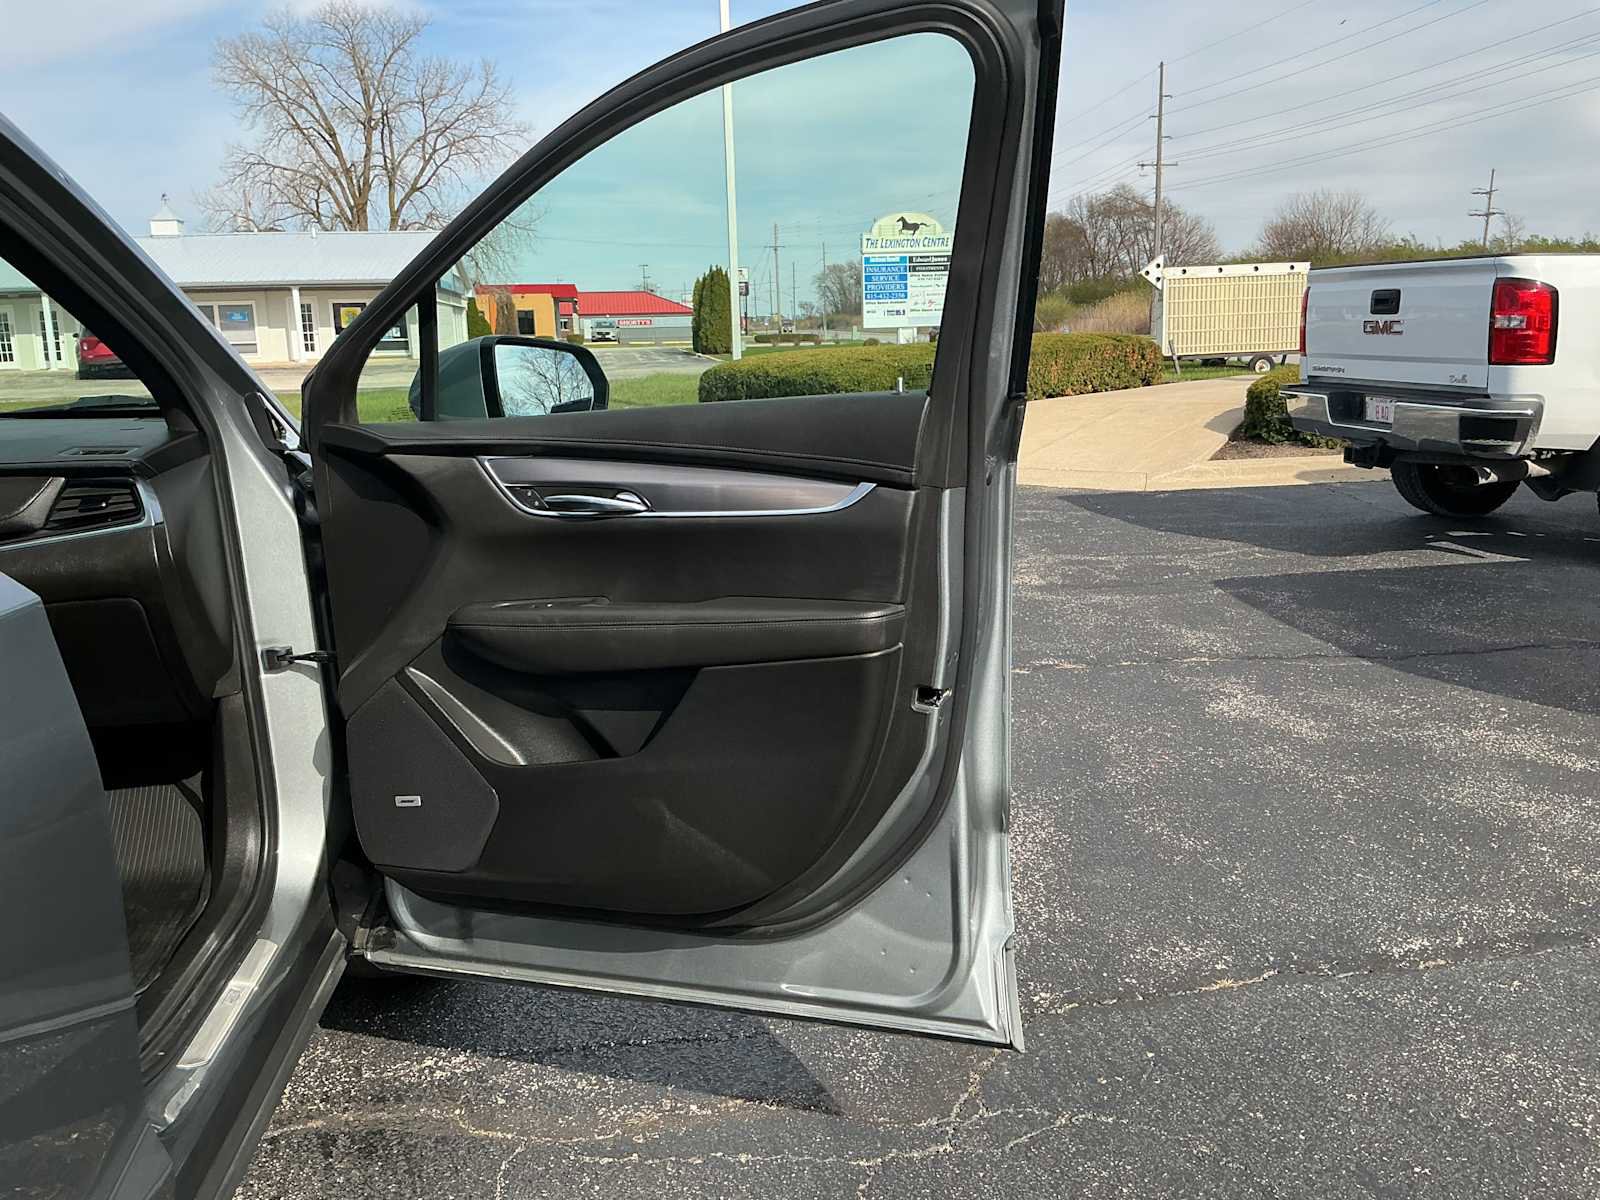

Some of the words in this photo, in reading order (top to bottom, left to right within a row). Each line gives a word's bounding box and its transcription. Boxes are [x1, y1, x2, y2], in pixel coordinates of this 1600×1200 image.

[865, 238, 879, 249] THE
[880, 237, 920, 249] LEXINGTON
[922, 236, 950, 248] CENTRE
[866, 265, 905, 273] INSURANCE
[866, 283, 905, 291] PROVIDERS
[1363, 320, 1404, 335] GMC
